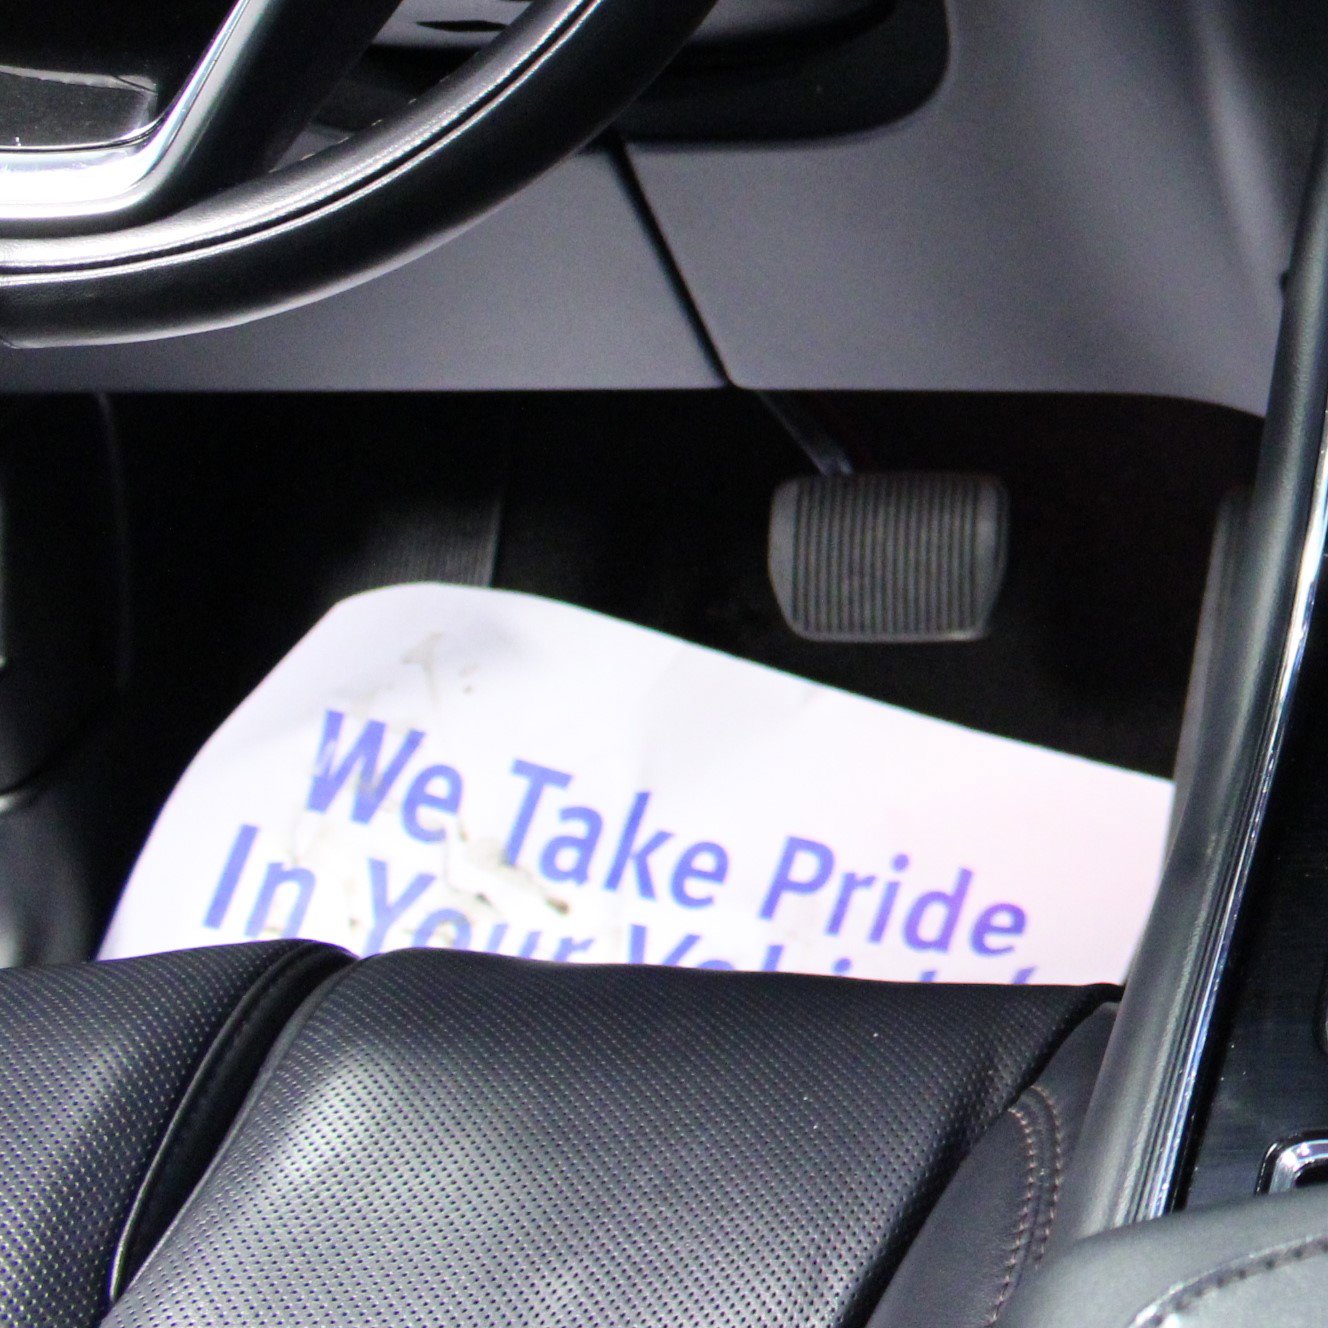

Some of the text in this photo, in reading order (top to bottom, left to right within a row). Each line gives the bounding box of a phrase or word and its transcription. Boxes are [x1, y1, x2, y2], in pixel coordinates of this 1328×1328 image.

[203, 824, 317, 939] In
[306, 709, 465, 845] We
[502, 758, 730, 910] Take
[757, 835, 1027, 958] Pride
